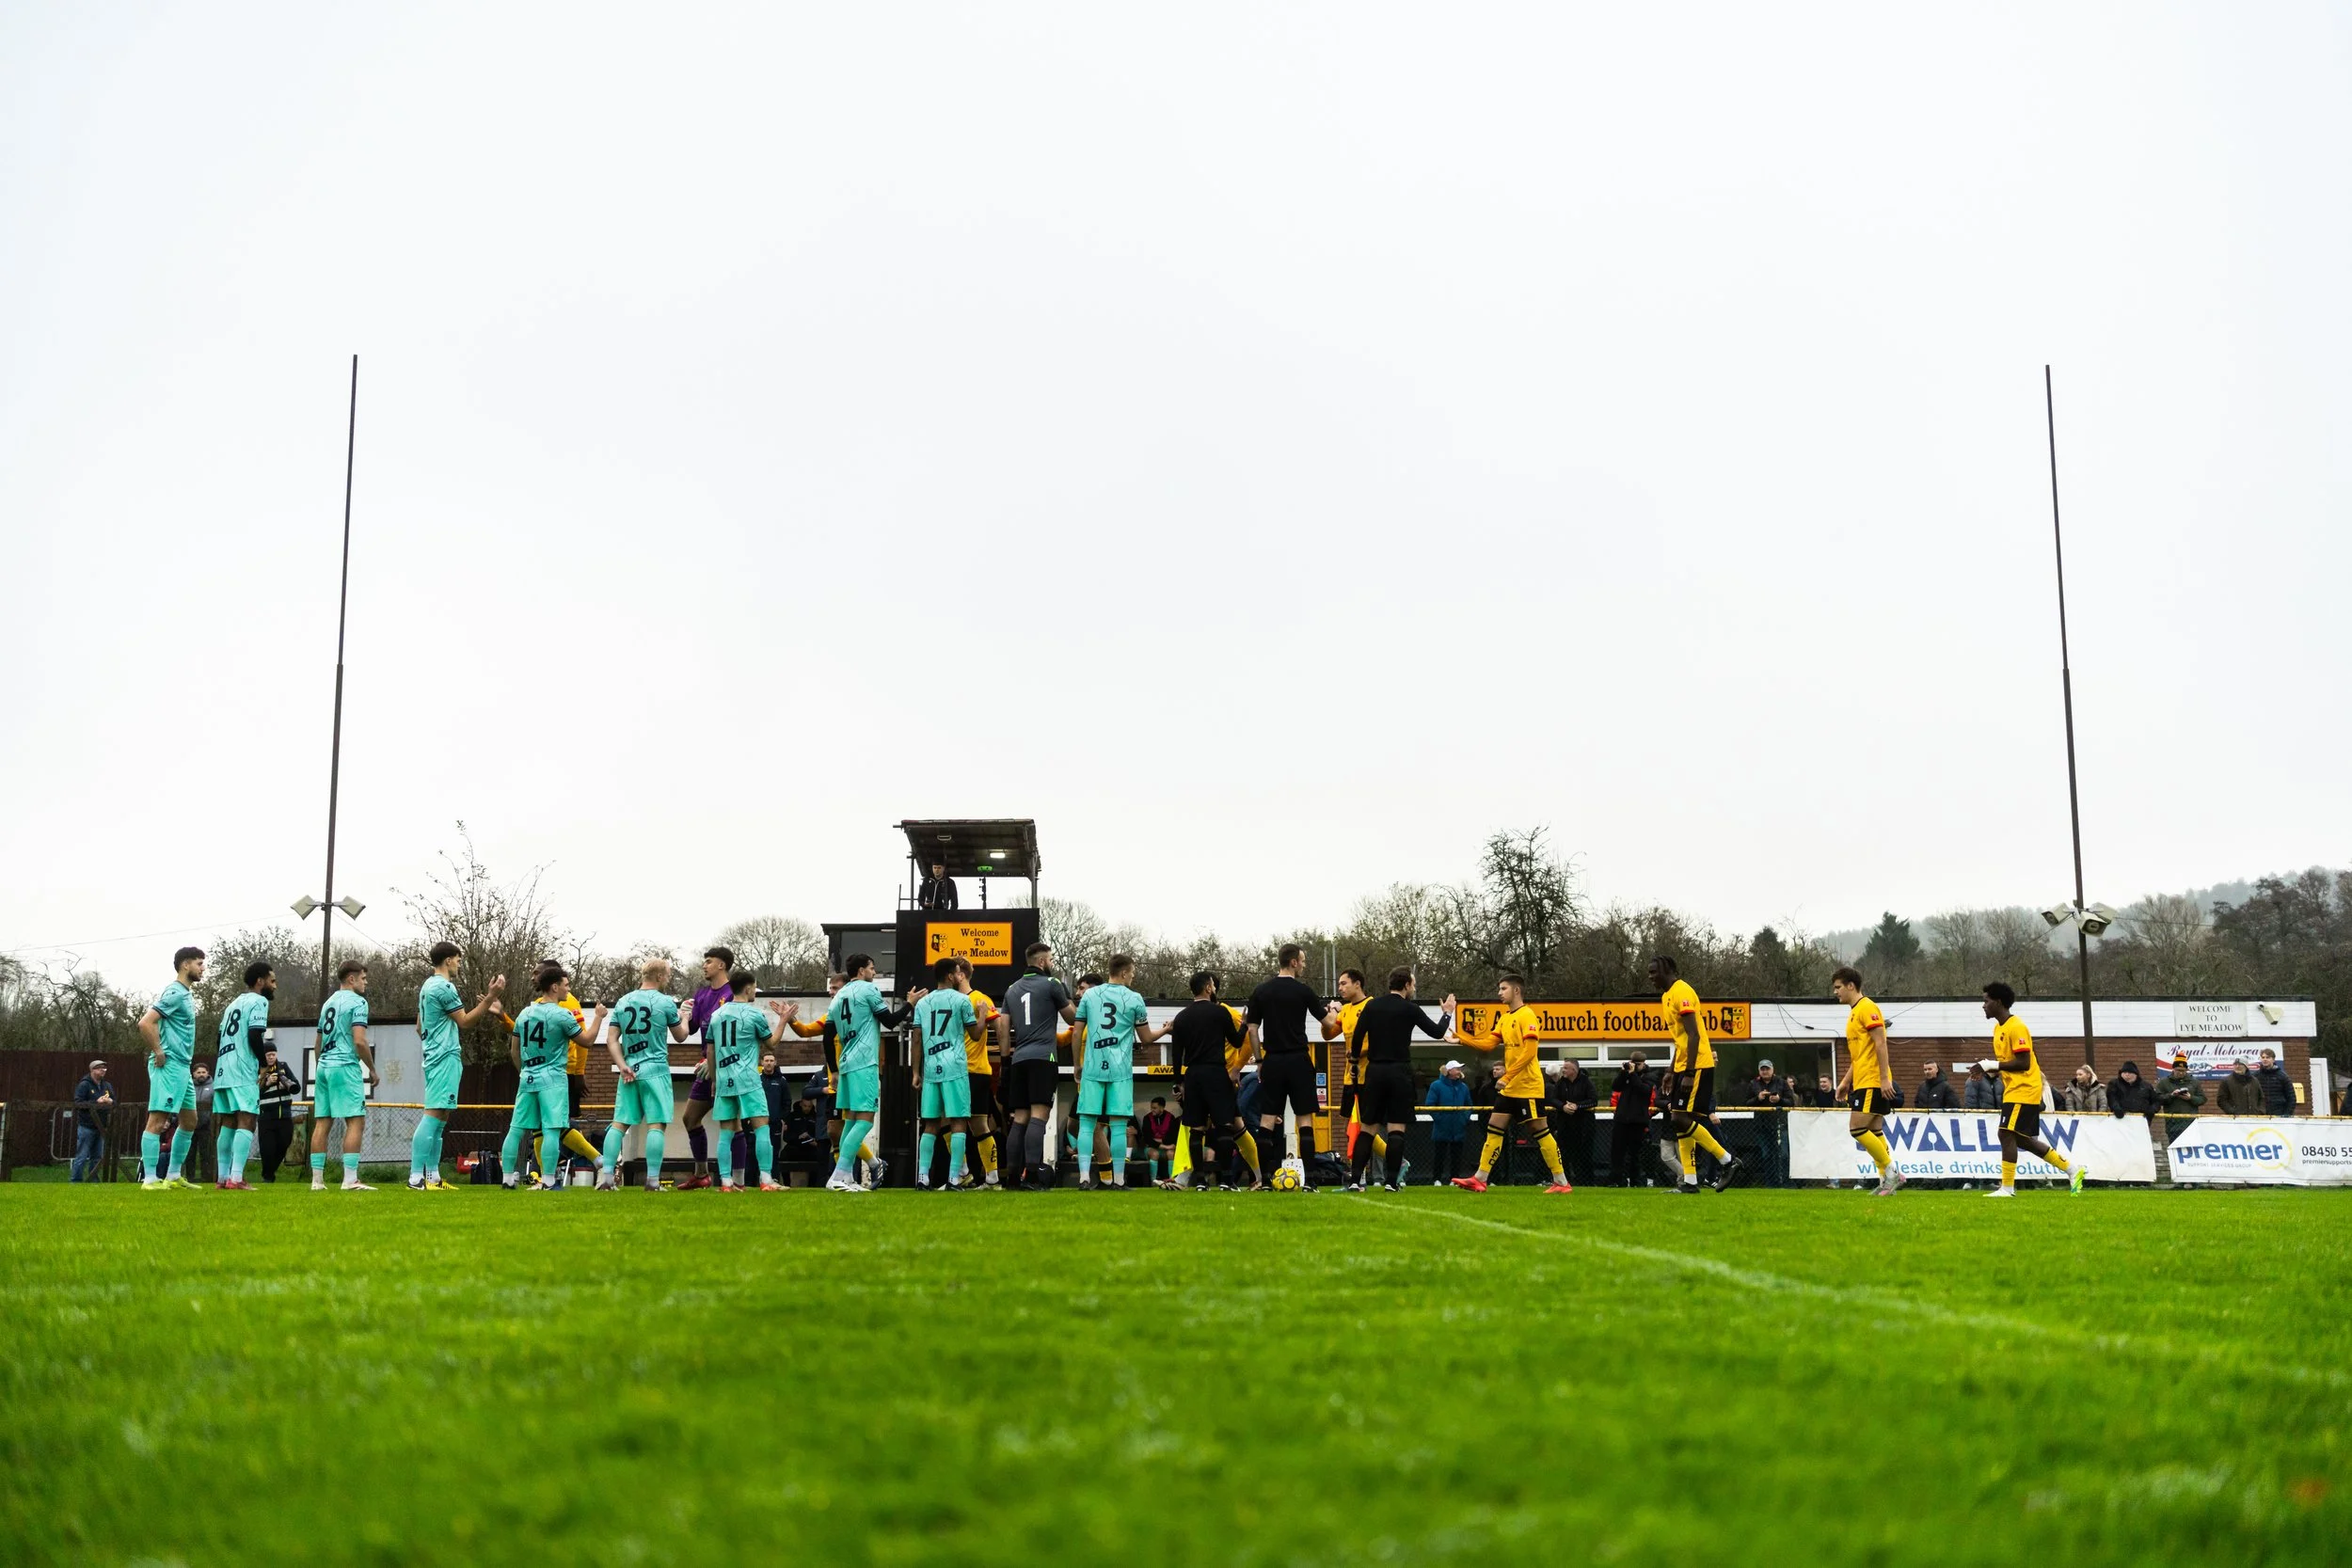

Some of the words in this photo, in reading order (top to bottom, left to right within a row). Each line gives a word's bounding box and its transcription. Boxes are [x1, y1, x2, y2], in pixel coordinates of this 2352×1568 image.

[961, 928, 999, 937] Welcome
[974, 938, 985, 946] To
[970, 948, 1009, 957] Meadow
[624, 1006, 652, 1035] 23
[840, 997, 852, 1025] 4
[1021, 992, 1031, 1025] 1
[1100, 1002, 1117, 1030] 3
[222, 1008, 242, 1037] 18
[523, 1020, 548, 1049] 14
[721, 1020, 737, 1047] 11
[930, 1008, 953, 1037] 17
[2199, 1023, 2244, 1032] MEADOW
[2168, 1044, 2206, 1059] Ryal
[2207, 1043, 2260, 1055] Motorwa
[1856, 1116, 2079, 1152] WALLW
[2177, 1143, 2282, 1164] premier
[2301, 1146, 2337, 1157] 08450
[1857, 1160, 1944, 1174] whlesale
[1949, 1160, 2002, 1174] drinks
